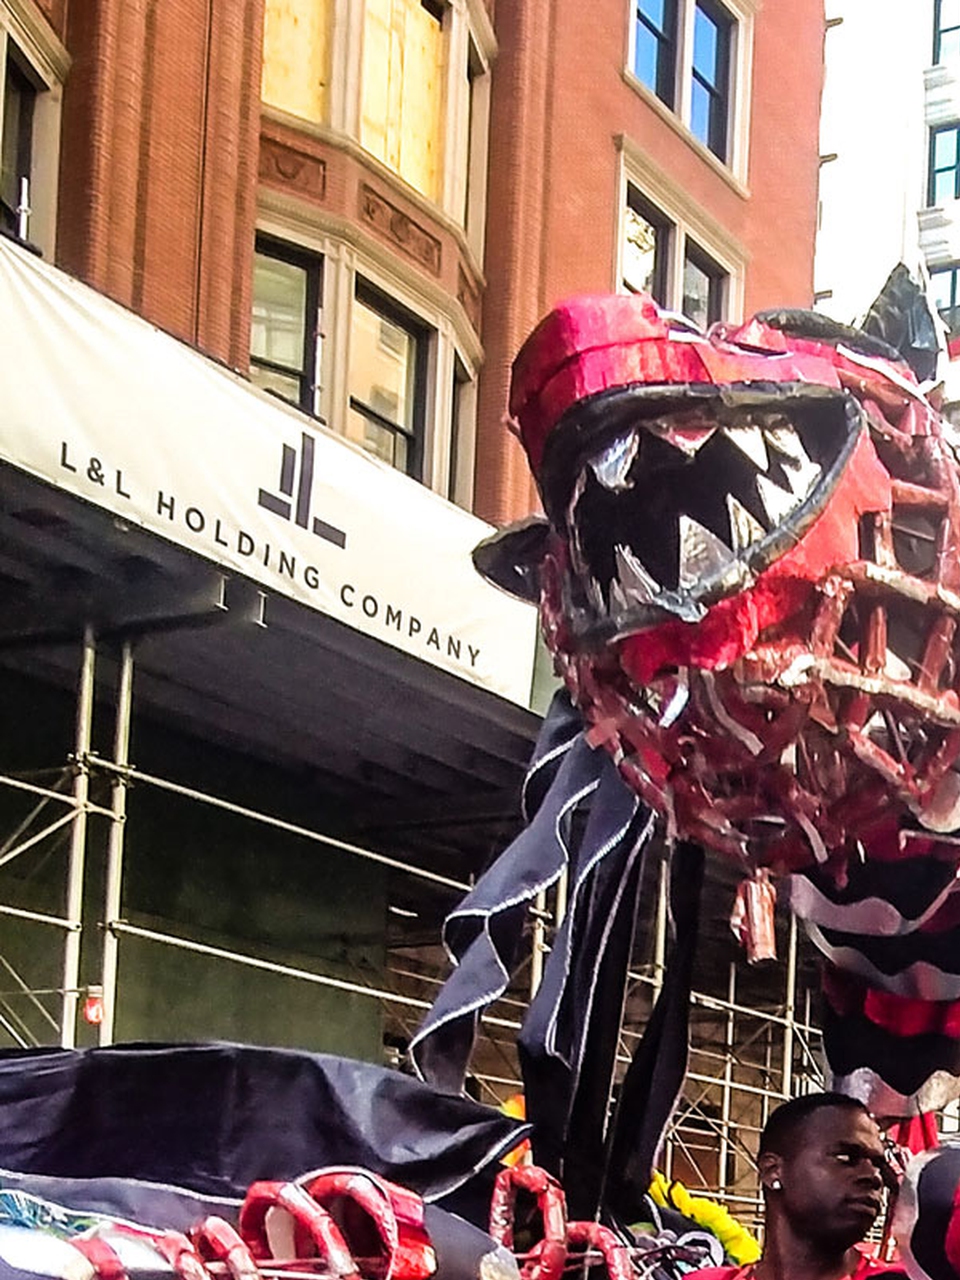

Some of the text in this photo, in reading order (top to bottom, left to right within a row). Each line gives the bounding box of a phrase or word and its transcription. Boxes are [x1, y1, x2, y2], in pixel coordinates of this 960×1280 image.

[60, 441, 481, 667] L&L HOLDING COMPANY
